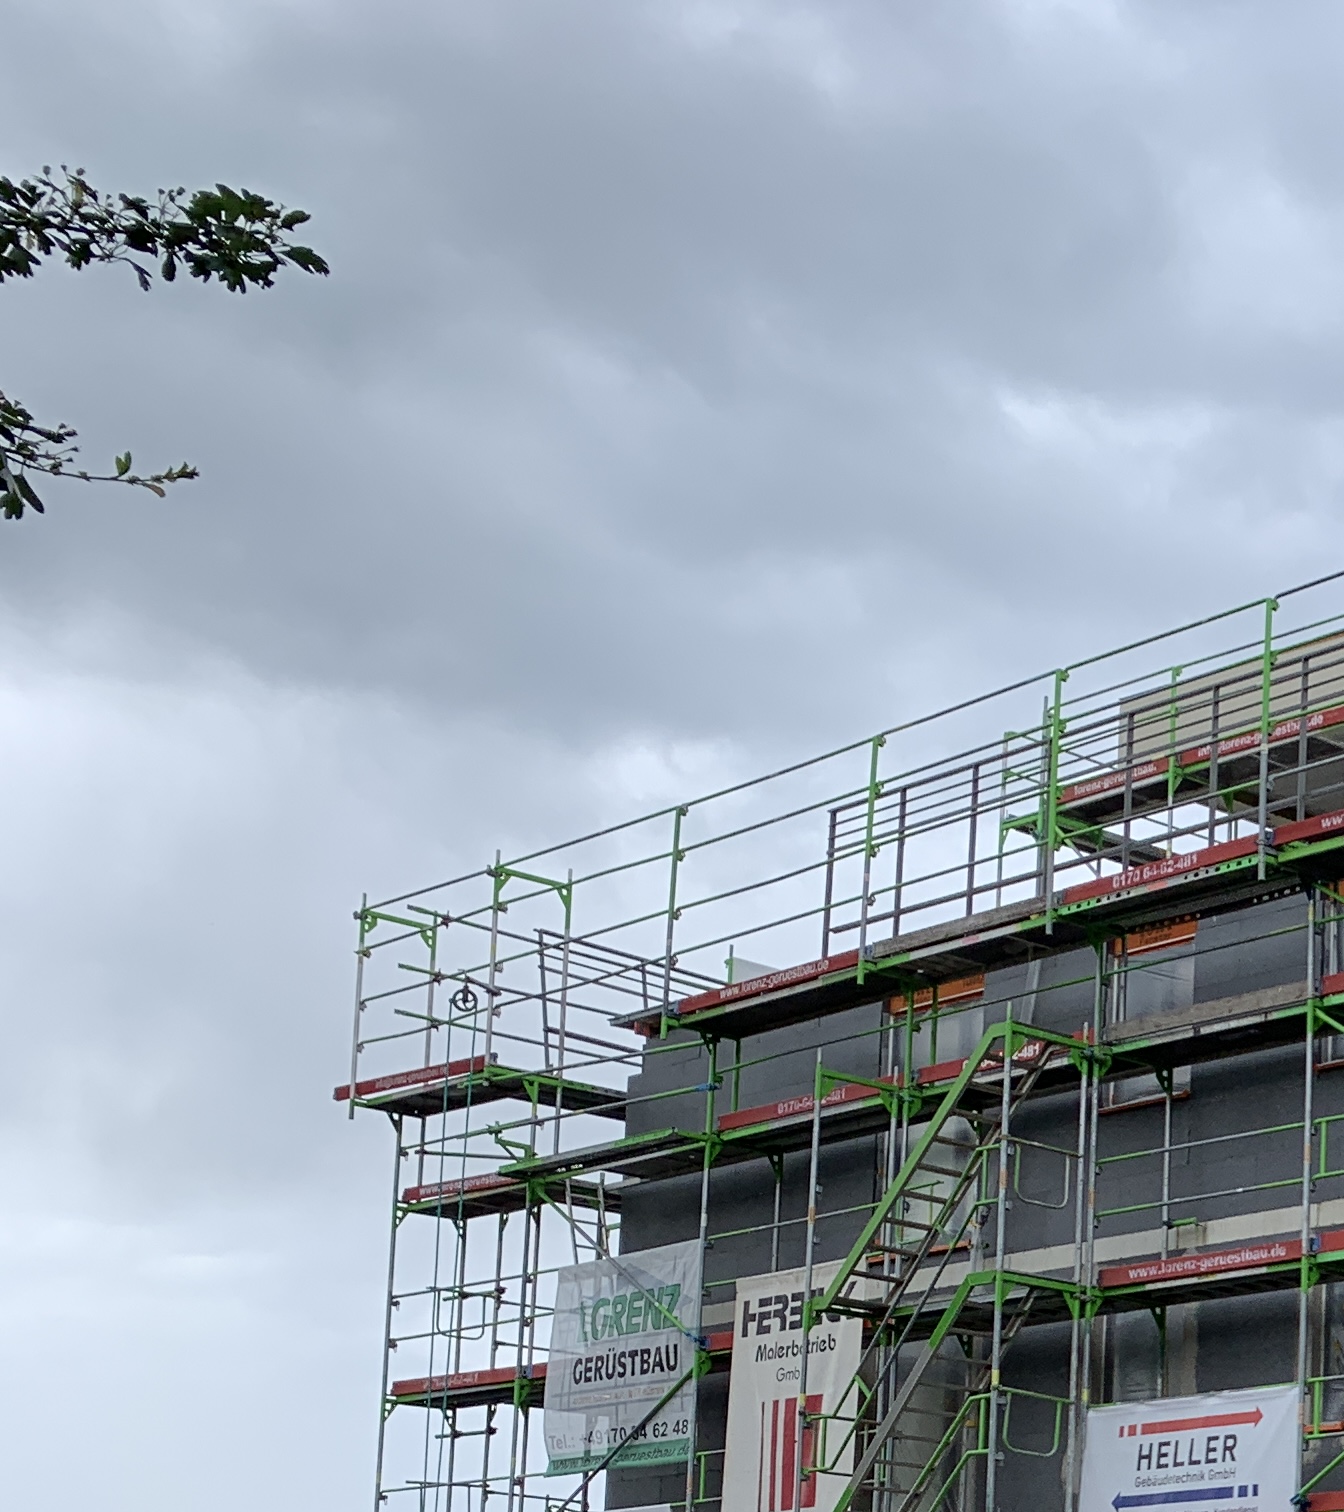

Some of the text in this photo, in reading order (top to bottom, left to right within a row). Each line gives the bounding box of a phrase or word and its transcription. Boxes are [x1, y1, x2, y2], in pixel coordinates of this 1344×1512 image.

[1128, 1244, 1287, 1280] www.lorenz-geruestbau.de
[573, 1343, 678, 1385] GERÜSTBAU
[653, 1422, 668, 1438] 62
[1136, 1433, 1238, 1472] HELLER
[1134, 1467, 1236, 1489] Gebäudetechnik GmbH
